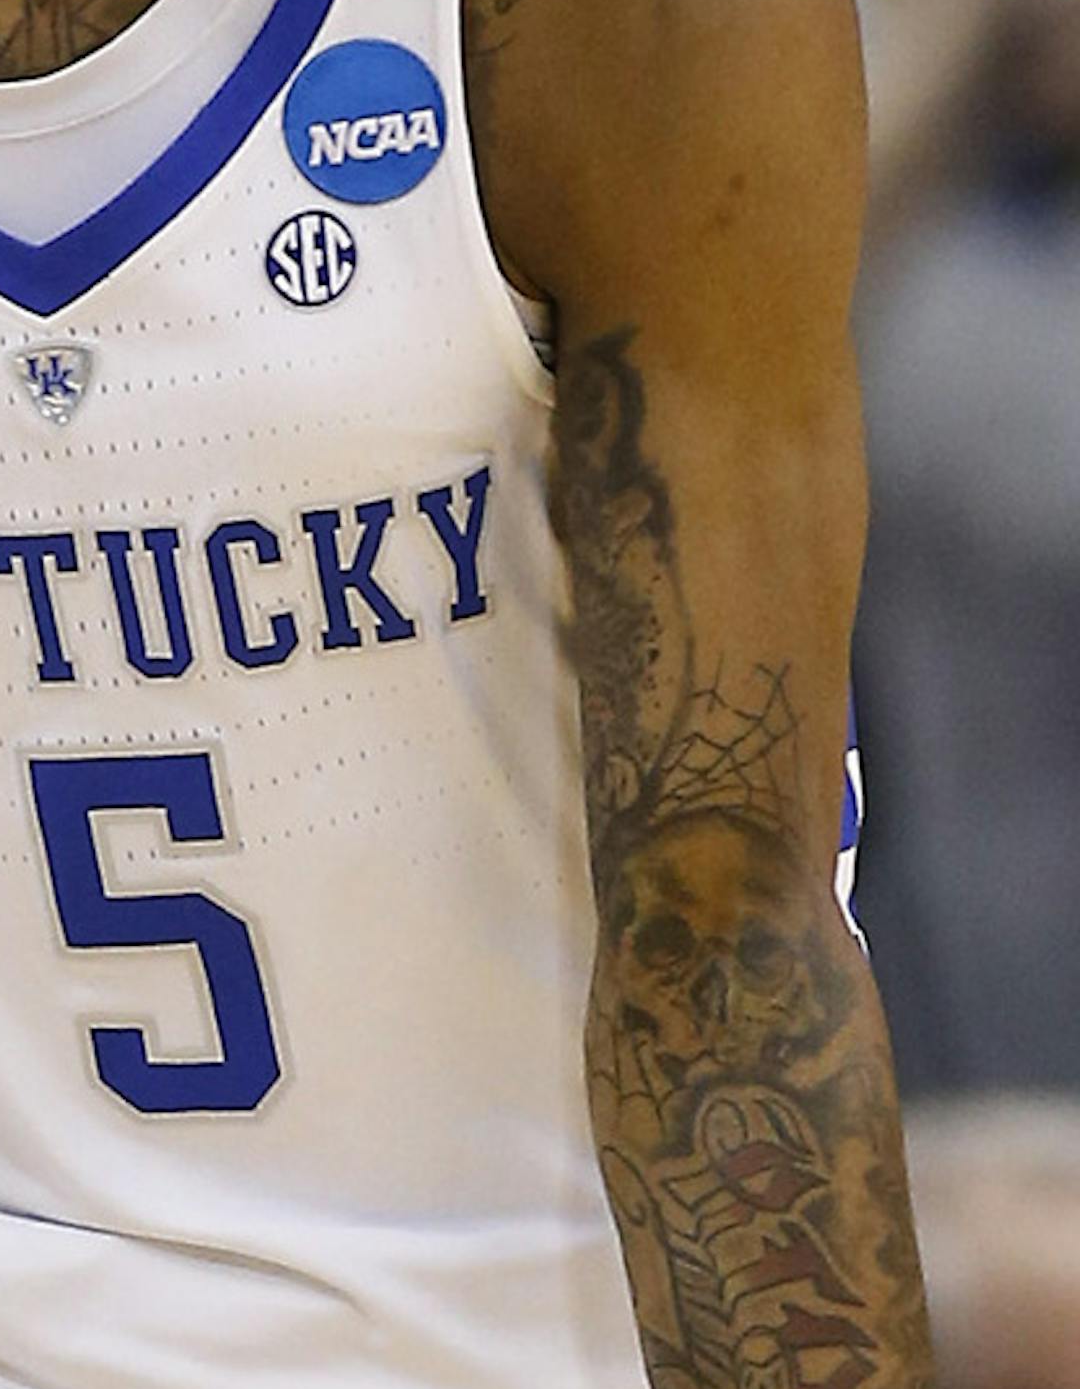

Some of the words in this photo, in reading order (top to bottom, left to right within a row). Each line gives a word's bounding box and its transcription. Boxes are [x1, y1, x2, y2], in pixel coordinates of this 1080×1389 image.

[307, 107, 440, 168] NCAA
[269, 213, 354, 303] SEC
[26, 356, 78, 397] UK
[28, 751, 282, 1114] 5
